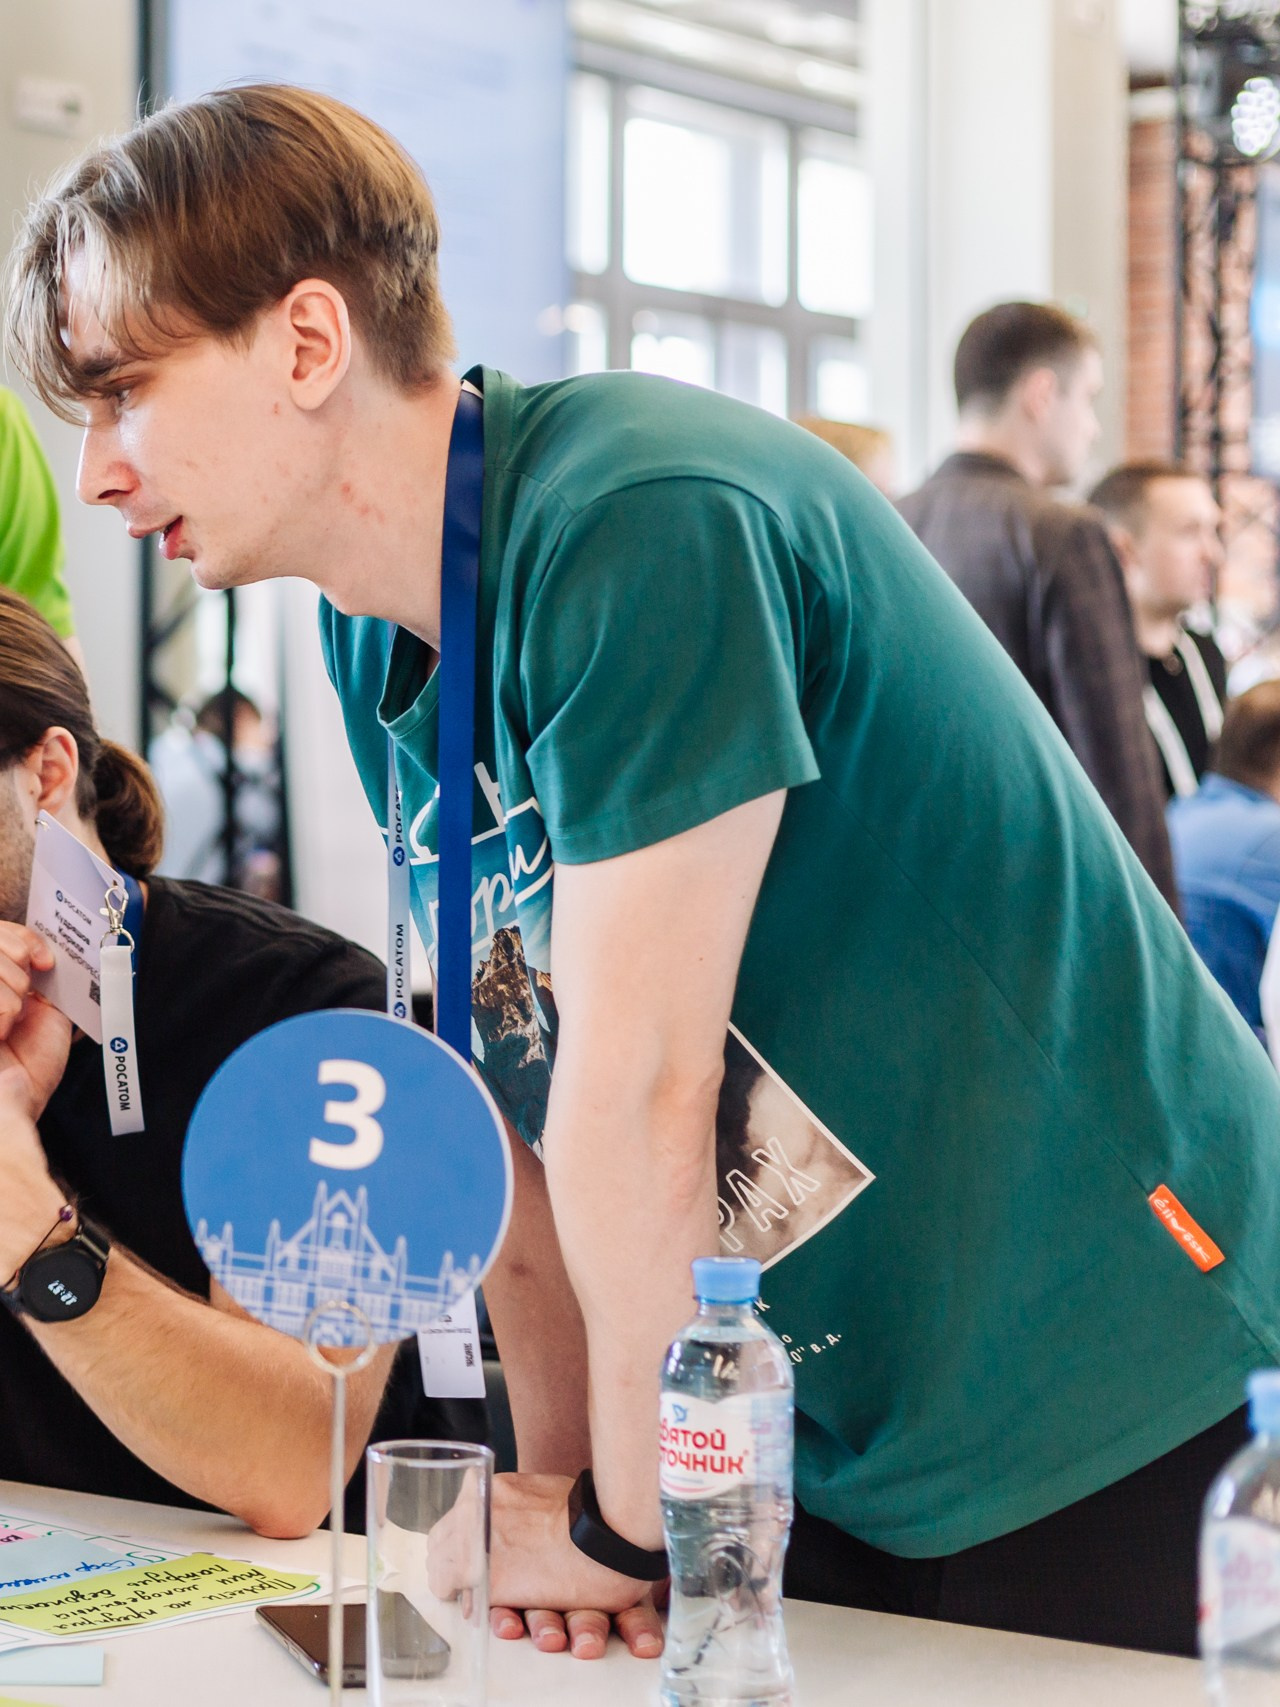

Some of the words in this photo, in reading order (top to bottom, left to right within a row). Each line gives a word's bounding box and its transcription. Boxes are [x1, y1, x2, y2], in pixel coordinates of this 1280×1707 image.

[395, 784, 403, 844] РОСАТ
[63, 897, 92, 926] РОСАТОМ
[395, 923, 404, 999] РОСАТОМ
[115, 1055, 131, 1112] РОСАТОМ
[308, 1058, 387, 1171] 3
[718, 1136, 821, 1253] РАХ
[660, 1417, 726, 1452] ВЯТОЙ
[660, 1445, 744, 1474] ТОЧНИК
[126, 1564, 230, 1588] патруль
[201, 1578, 297, 1601] Провести
[163, 1600, 194, 1610] на
